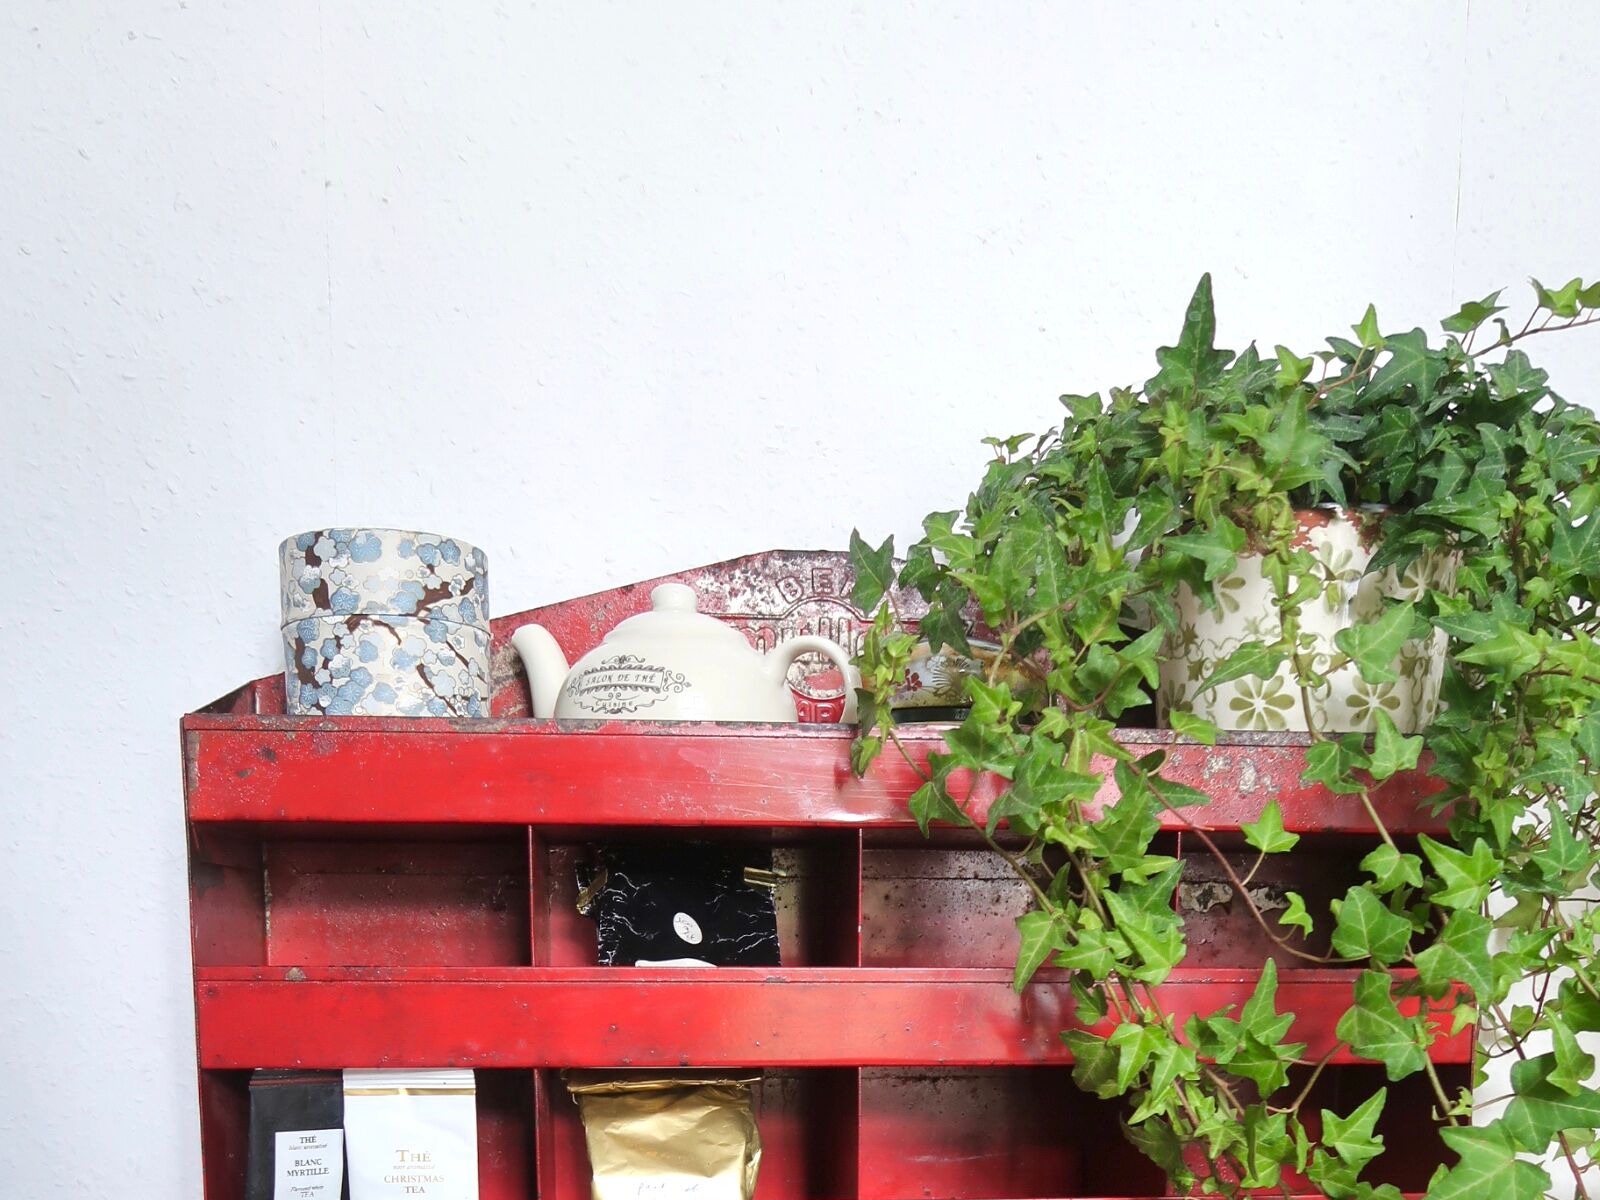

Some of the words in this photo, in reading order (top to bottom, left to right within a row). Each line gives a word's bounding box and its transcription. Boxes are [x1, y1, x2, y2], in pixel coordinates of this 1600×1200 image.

[585, 673, 612, 686] SALON
[617, 673, 630, 682] DE
[634, 673, 657, 683] THÉ
[299, 1134, 317, 1144] THÉ
[294, 1158, 323, 1167] BLANC
[286, 1168, 330, 1177] MYRTILLE
[383, 1174, 446, 1184] CHRISTMAS
[404, 1185, 426, 1194] TEA
